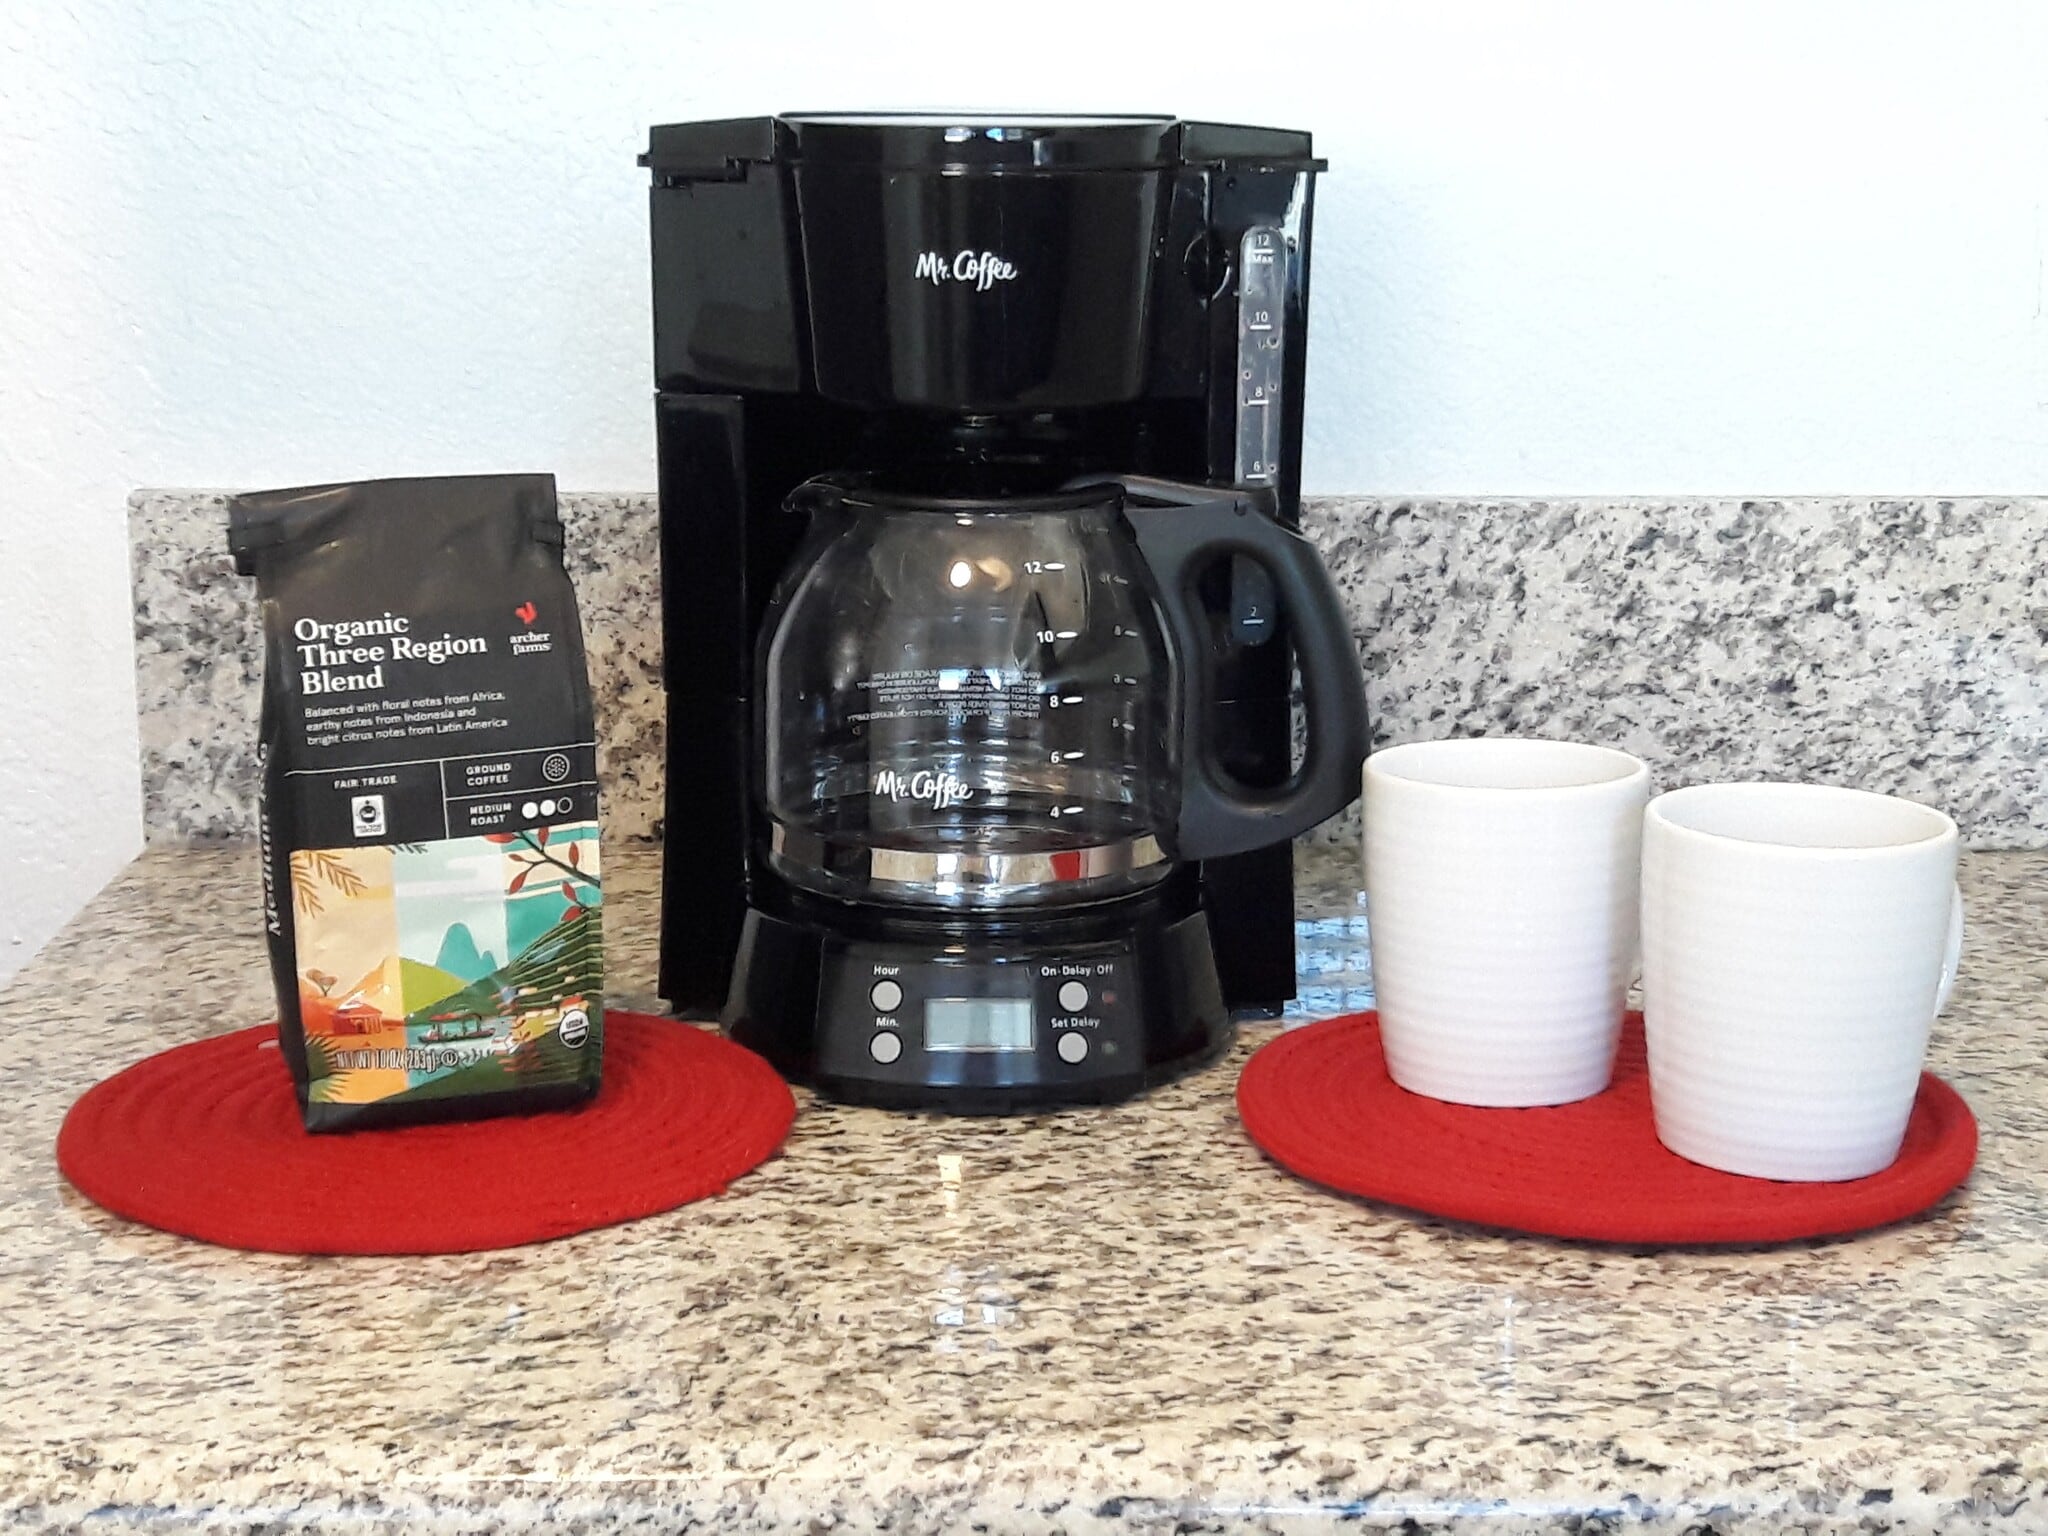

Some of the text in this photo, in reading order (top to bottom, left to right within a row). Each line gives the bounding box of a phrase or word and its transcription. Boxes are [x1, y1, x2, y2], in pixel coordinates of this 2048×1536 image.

[1257, 233, 1270, 247] 12
[1253, 254, 1273, 265] Max
[915, 249, 1018, 292] Mr. Coffee
[1254, 311, 1269, 322] 10
[1255, 386, 1263, 398] 8
[1253, 461, 1260, 472] 6
[1024, 561, 1042, 575] 12
[1250, 606, 1257, 617] 2
[294, 612, 409, 646] Organic
[509, 631, 551, 645] archer
[1036, 630, 1054, 644] 10
[297, 633, 488, 668] Three Region
[513, 642, 553, 656] farms
[301, 665, 385, 695] Blend
[304, 705, 354, 719] Balanced
[356, 702, 380, 714] with
[382, 700, 411, 711] floral
[412, 698, 443, 708] notes
[444, 694, 470, 705] from
[1050, 695, 1059, 708] 8
[306, 706, 477, 733] earthy notes from Indonesia and
[307, 718, 508, 747] bright citrus notes from Latin America
[1050, 752, 1059, 764] 6
[466, 762, 512, 776] GROUND
[334, 775, 398, 790] FAIR TRADE
[466, 775, 509, 787] COFFEE
[875, 770, 974, 810] Mr. Coffee
[469, 802, 512, 815] MEDIUM
[1050, 806, 1060, 819] 4
[470, 815, 506, 827] ROAST
[873, 964, 900, 976] Hour
[1041, 963, 1114, 977] On Delay Off
[876, 1016, 900, 1028] Min.
[1050, 1015, 1100, 1029] Set Delay
